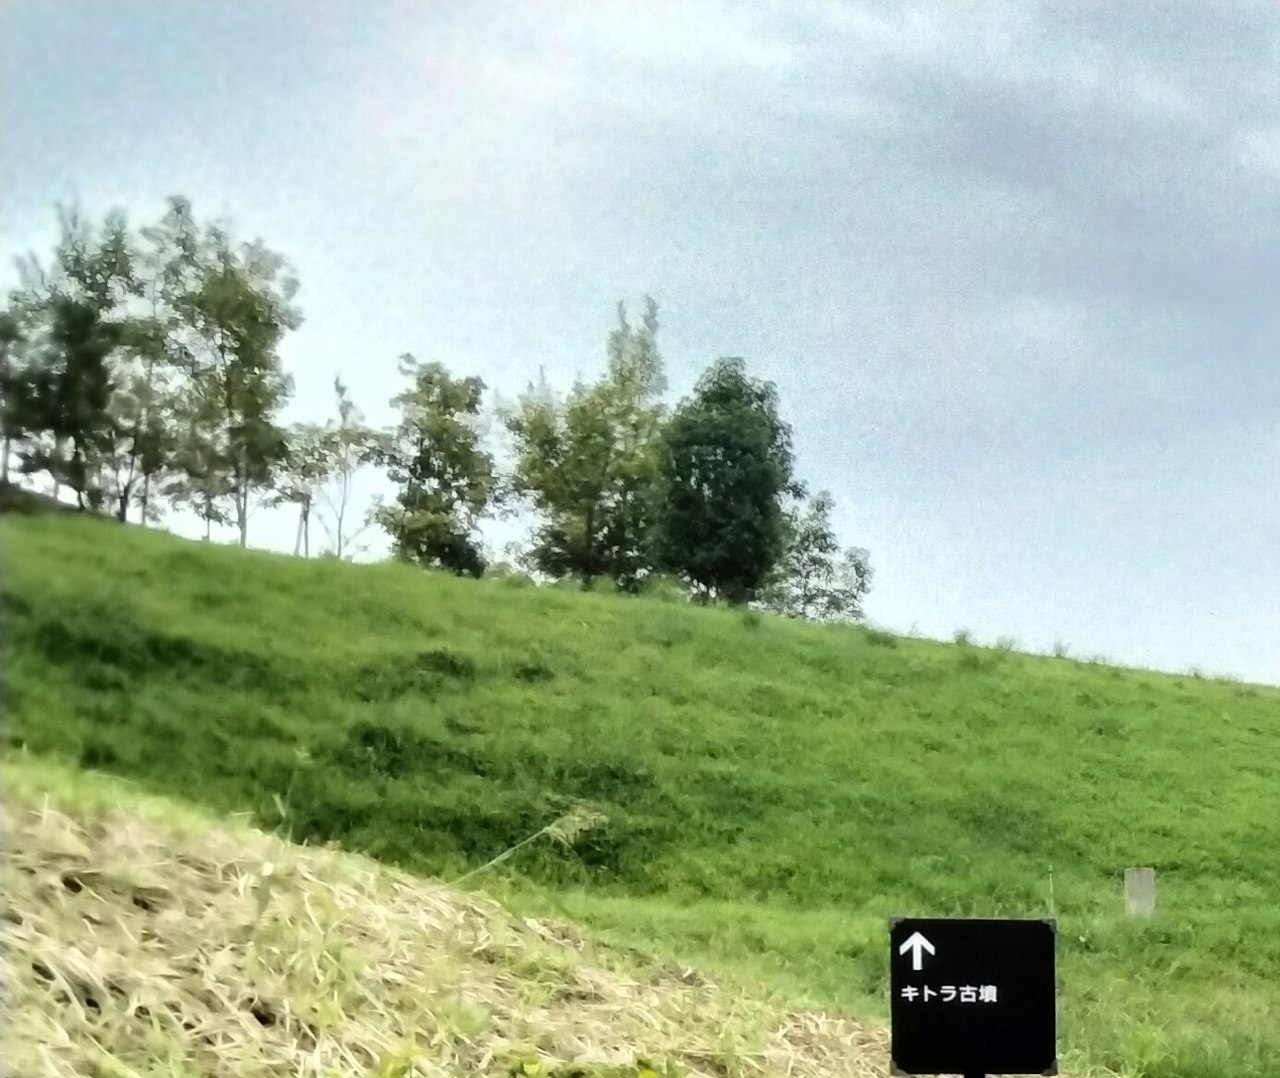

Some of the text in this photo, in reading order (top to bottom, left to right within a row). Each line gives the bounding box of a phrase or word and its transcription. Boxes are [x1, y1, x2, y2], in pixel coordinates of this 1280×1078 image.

[901, 984, 998, 1003] キトラ古墳
